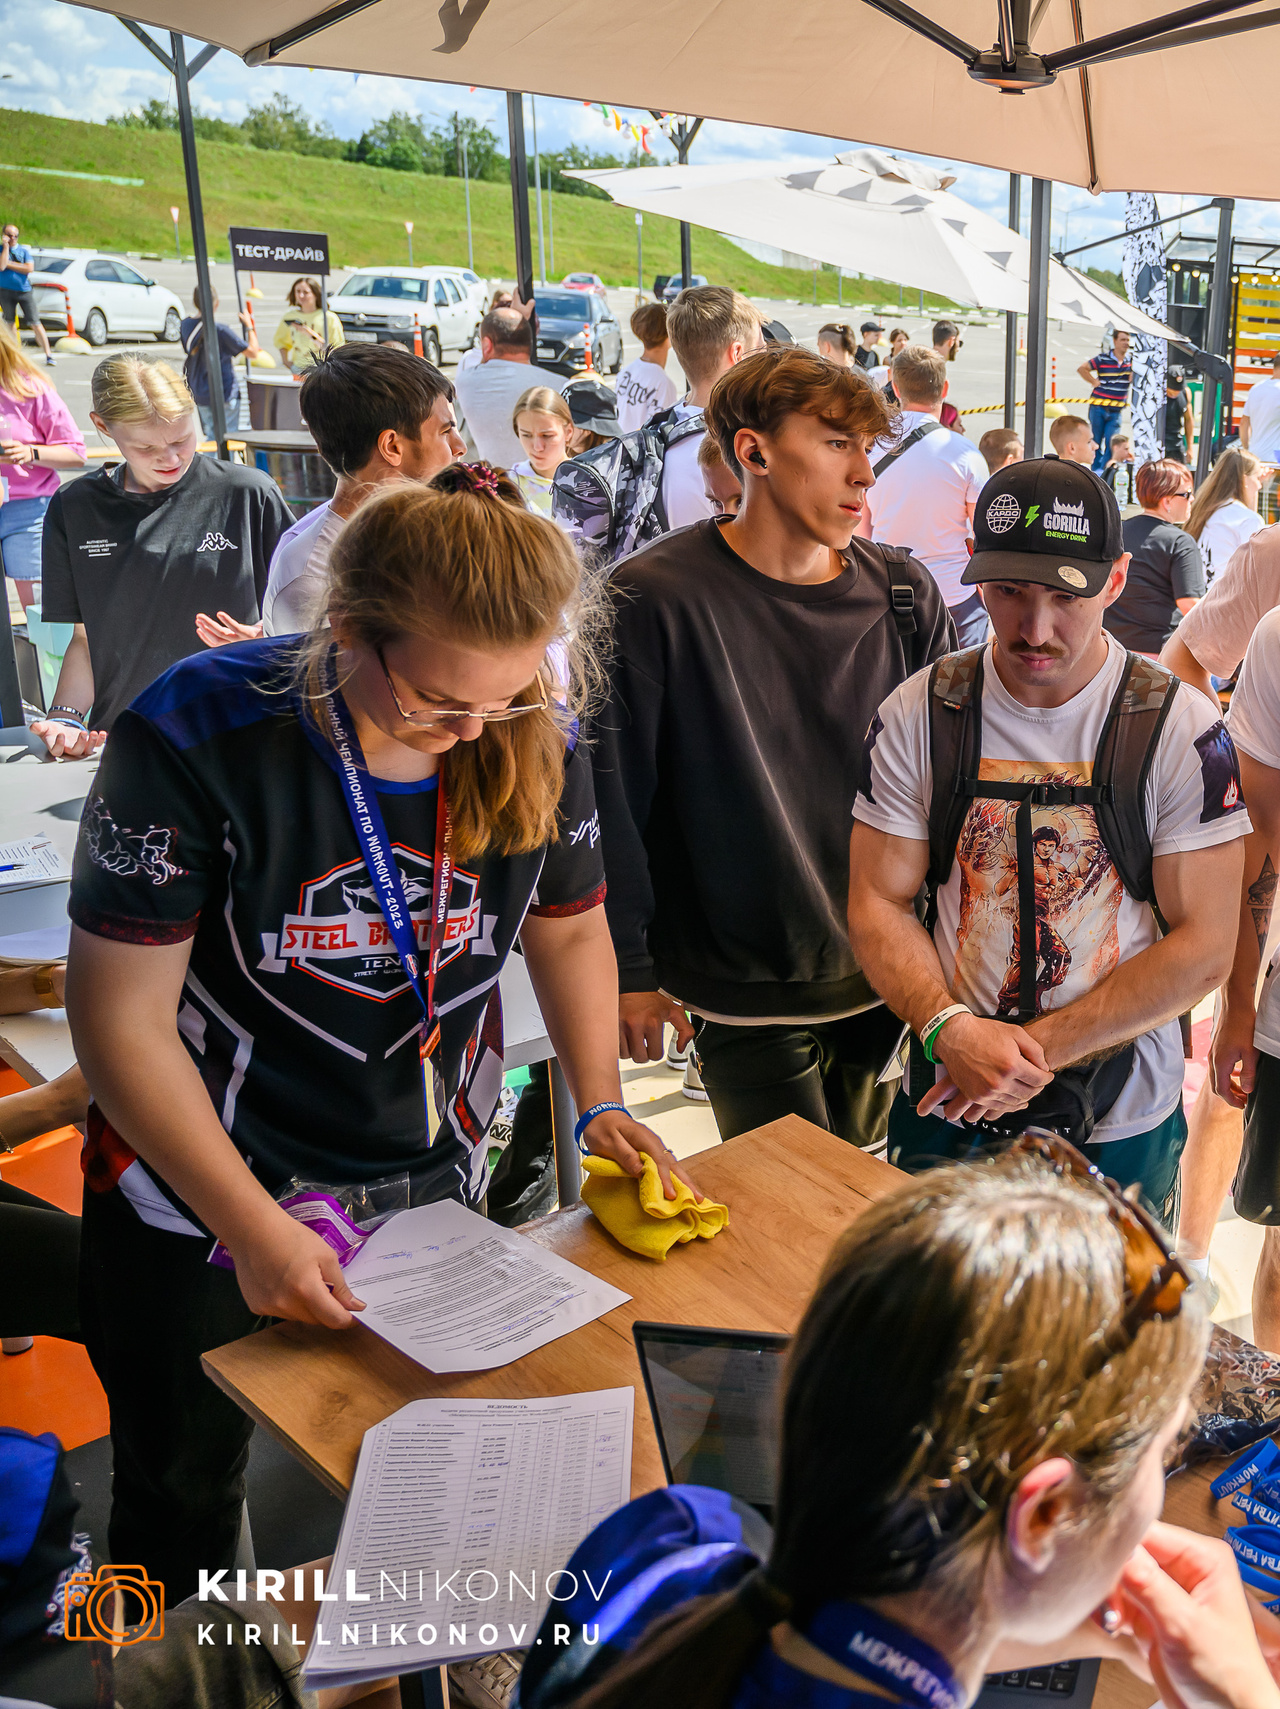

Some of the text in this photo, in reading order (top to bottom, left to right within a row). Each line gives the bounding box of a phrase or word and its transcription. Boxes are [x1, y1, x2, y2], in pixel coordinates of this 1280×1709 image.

[235, 243, 325, 262] ТЕСТ-ДРАЙВ
[988, 510, 1019, 518] КАРДО
[1043, 512, 1091, 536] GORILLA
[1045, 530, 1088, 543] ENERGY DRINK
[338, 740, 369, 815] ЧЕМПИОНАТ
[359, 815, 375, 835] ПО
[283, 923, 358, 950] STEEL
[588, 1101, 624, 1116] WORKOU
[1216, 1462, 1260, 1498] WORKOUT
